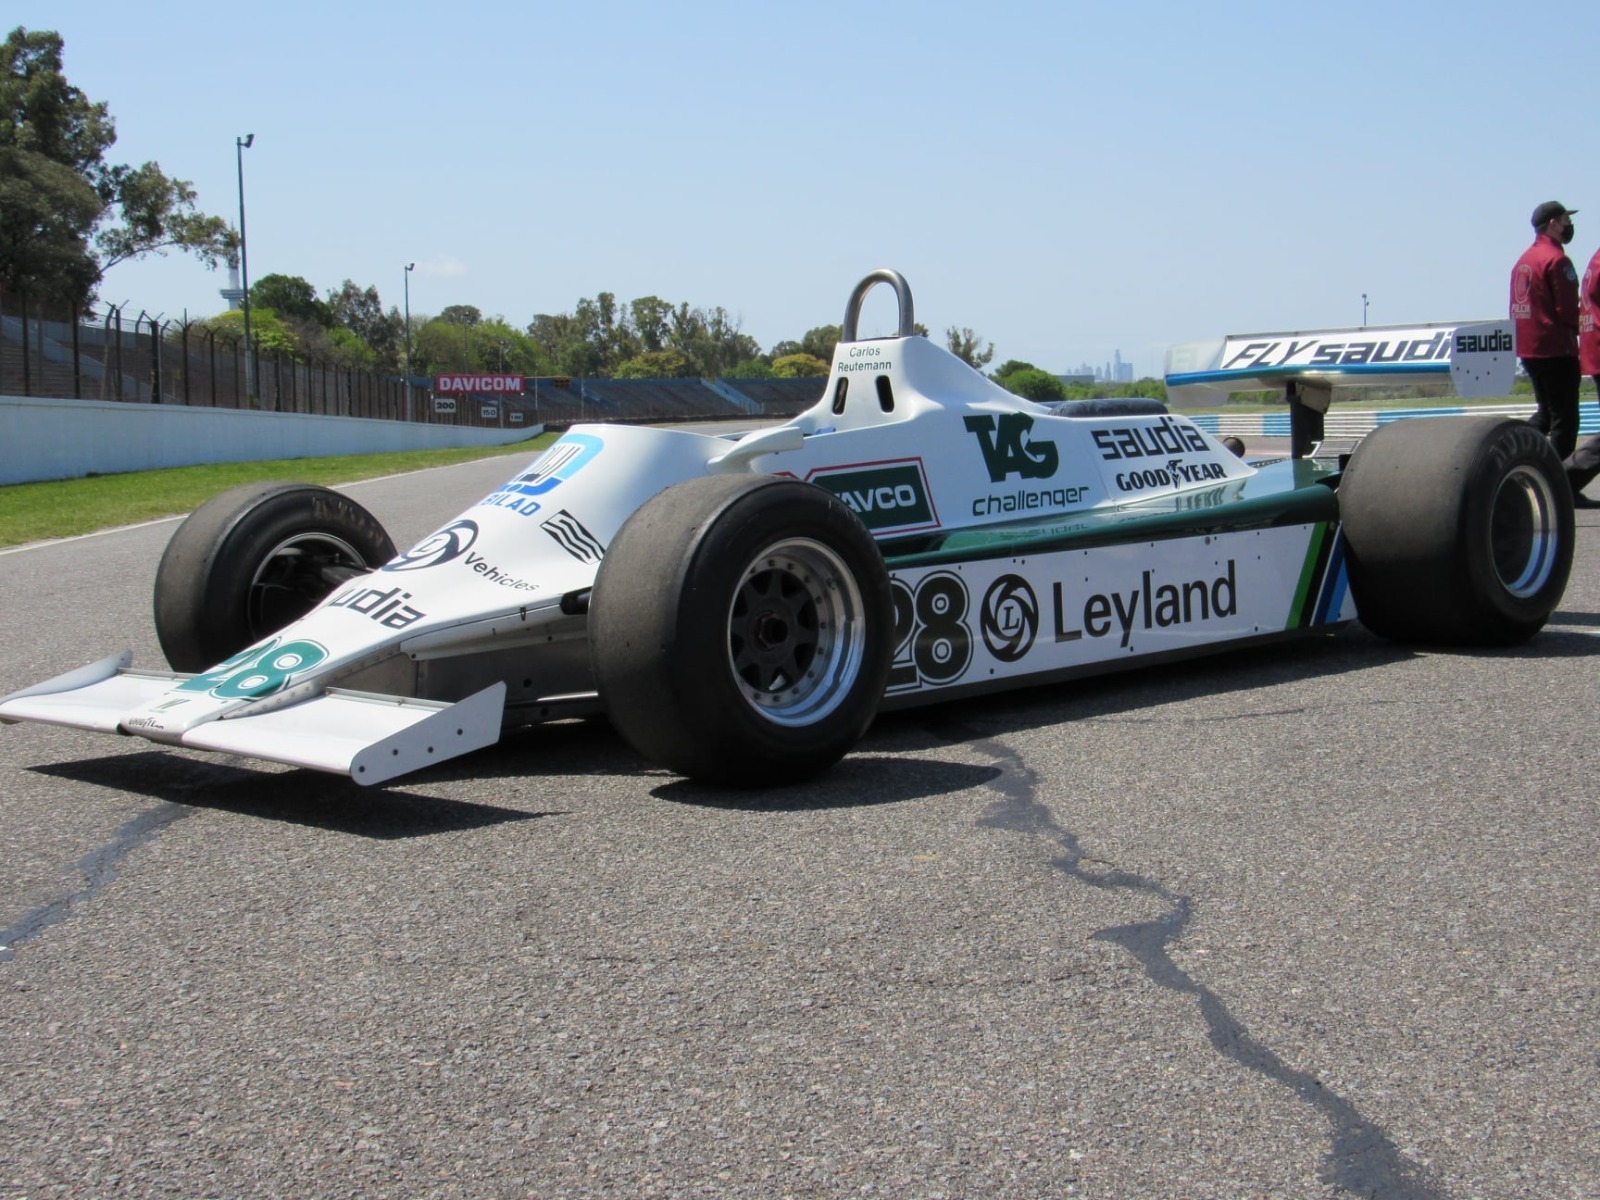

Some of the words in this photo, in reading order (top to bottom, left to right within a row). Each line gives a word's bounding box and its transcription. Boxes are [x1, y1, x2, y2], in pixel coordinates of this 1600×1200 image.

[849, 346, 881, 358] Carlos
[1222, 339, 1319, 369] FLY
[1309, 331, 1451, 365] saudi
[1456, 329, 1513, 353] saudia
[837, 361, 892, 372] Reutemann
[439, 377, 520, 391] DAVICOM
[436, 401, 455, 410] 200
[481, 409, 496, 417] 150
[963, 411, 1059, 483] TAG
[1091, 416, 1211, 460] saudia
[829, 483, 918, 514] AVCO
[972, 486, 1089, 517] challenger
[463, 551, 541, 592] Vehicles
[328, 587, 427, 630] udia
[1053, 559, 1238, 648] Leyland
